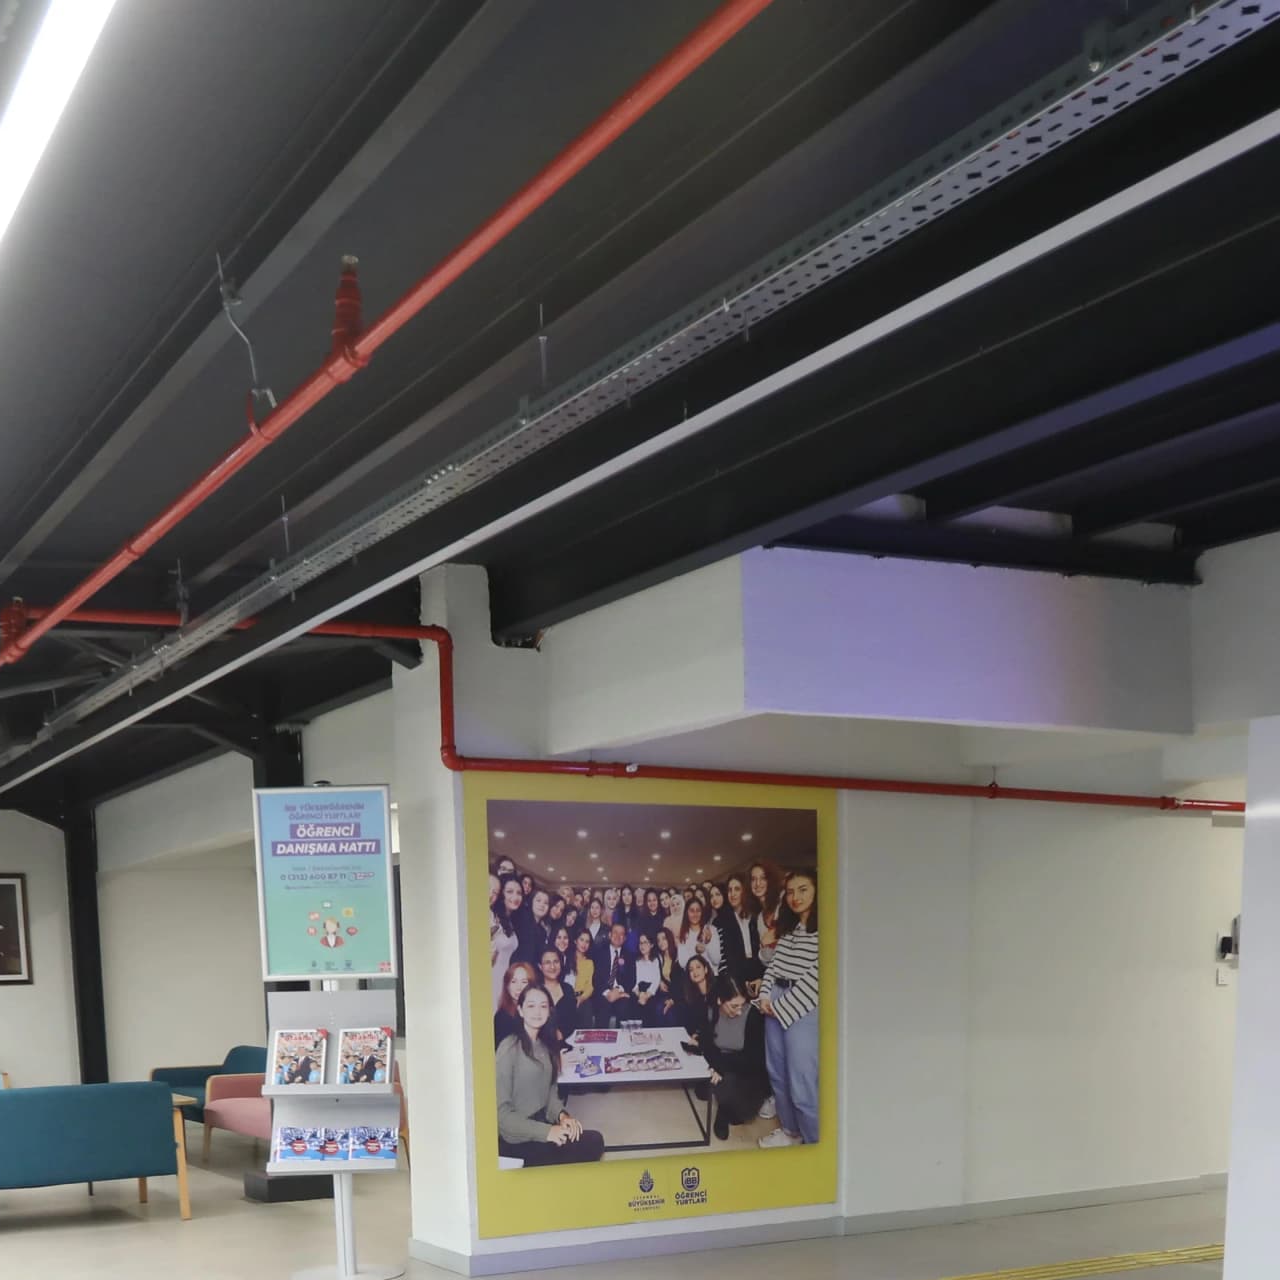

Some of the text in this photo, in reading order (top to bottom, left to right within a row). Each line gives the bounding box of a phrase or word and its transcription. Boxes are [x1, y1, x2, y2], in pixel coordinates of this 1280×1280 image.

[296, 822, 355, 838] ÖĞRENCİ
[276, 841, 377, 856] DANIŞMA HATTI
[674, 1189, 707, 1200] ÖĞRENCİ
